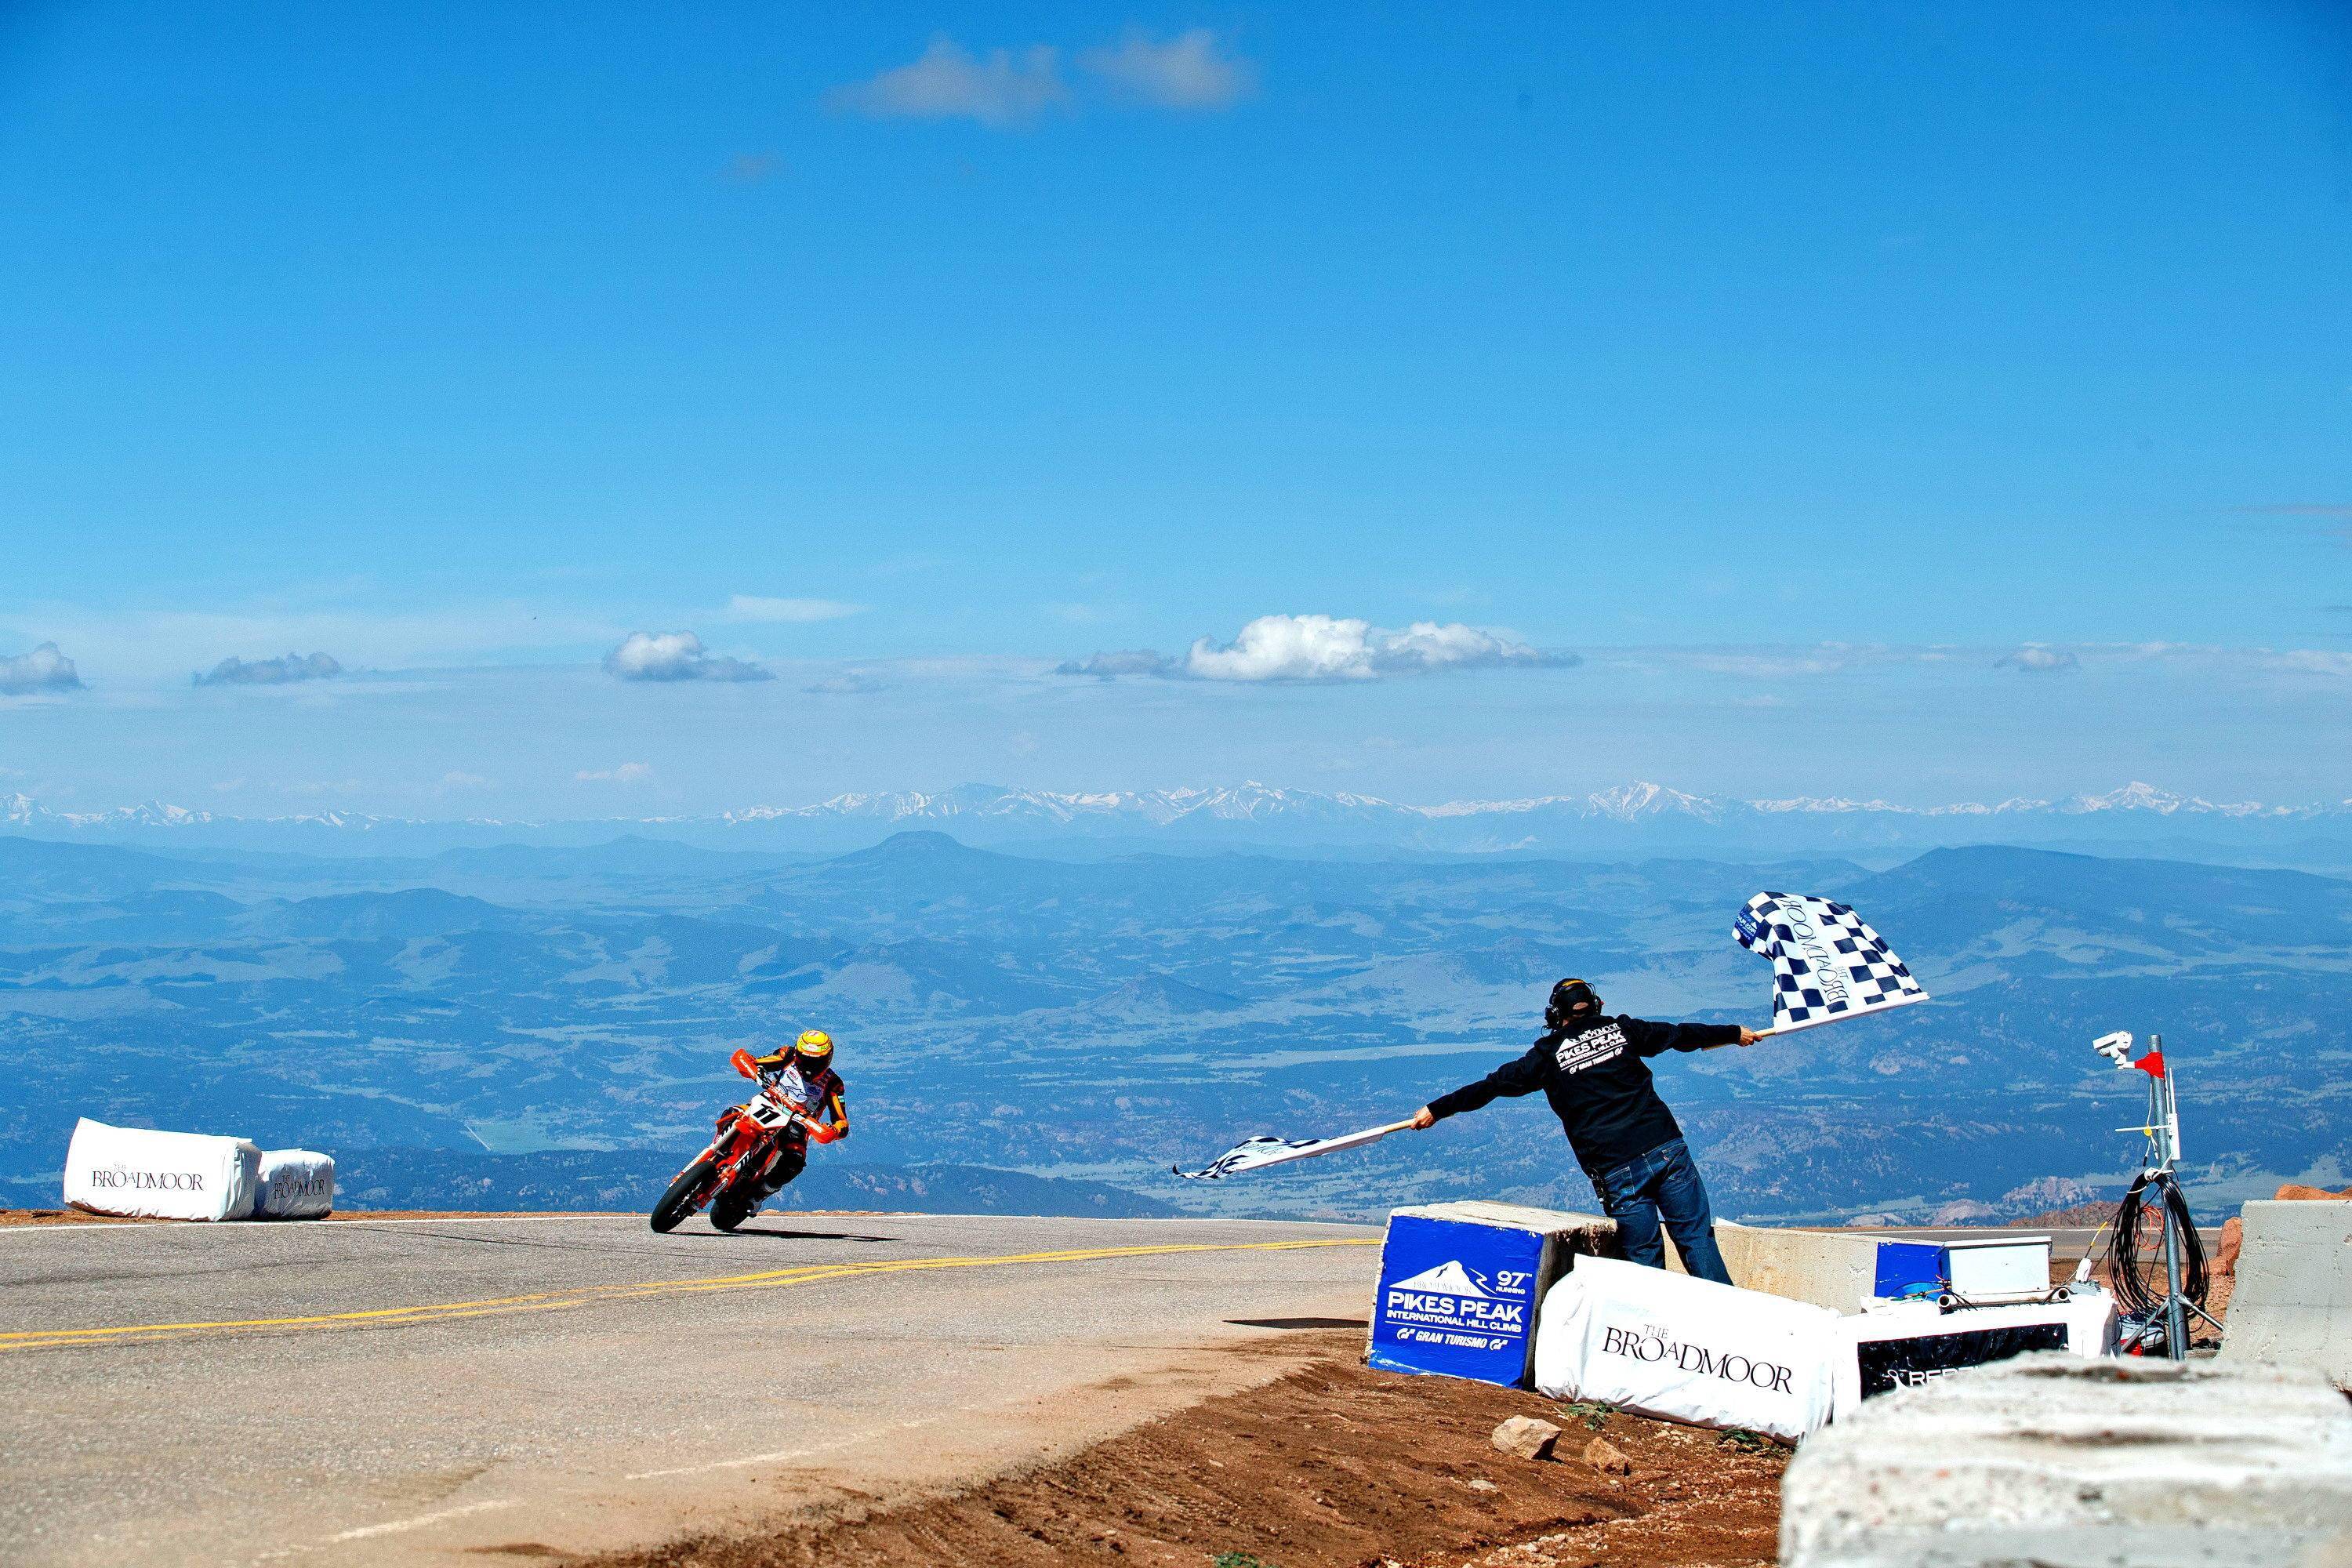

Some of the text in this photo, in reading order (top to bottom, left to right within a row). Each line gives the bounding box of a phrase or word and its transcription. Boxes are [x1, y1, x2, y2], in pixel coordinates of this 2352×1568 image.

[1578, 1023, 1621, 1041] BROADMOOR
[1556, 1030, 1624, 1063] PIKES PEAK
[1559, 1049, 1599, 1068] INTERNATIONAL
[753, 1103, 781, 1125] 11
[92, 1171, 204, 1191] BROADMOOR
[274, 1179, 325, 1199] BROADMOOR
[1495, 1286, 1526, 1295] RUNNING
[1388, 1291, 1523, 1323] PIKES PEAK
[1386, 1309, 1522, 1333] INTERNATIONAL HILL CLIMB
[1643, 1323, 1669, 1339] THE
[1415, 1330, 1444, 1344] GRAN
[1444, 1334, 1488, 1348] TURISMO
[1602, 1327, 1793, 1395] BROADMOOR
